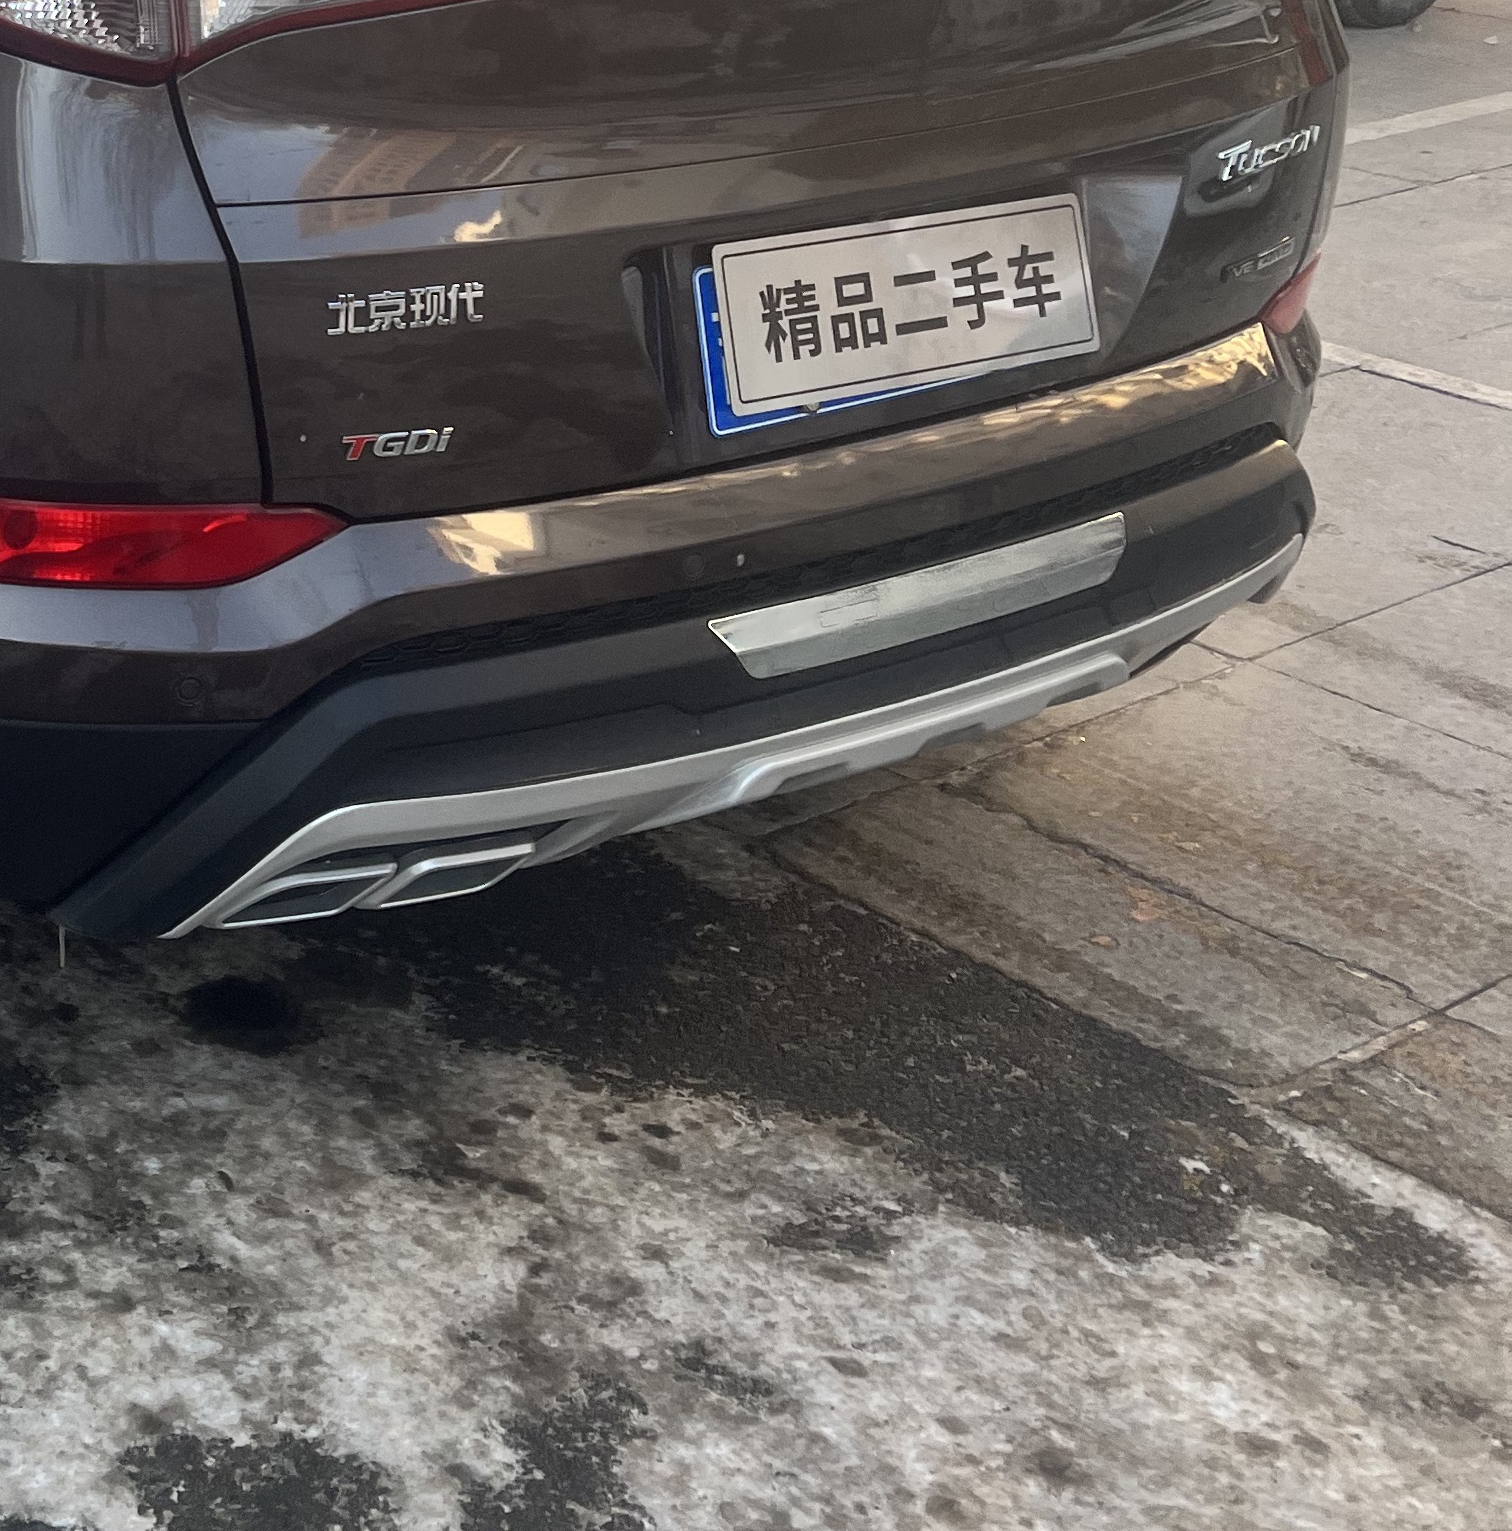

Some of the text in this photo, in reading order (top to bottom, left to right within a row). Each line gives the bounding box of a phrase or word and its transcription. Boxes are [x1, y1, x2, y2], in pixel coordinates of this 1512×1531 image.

[327, 281, 485, 336] 北京现代
[759, 244, 1062, 363] 精品二手车
[342, 426, 455, 461] TGDi
